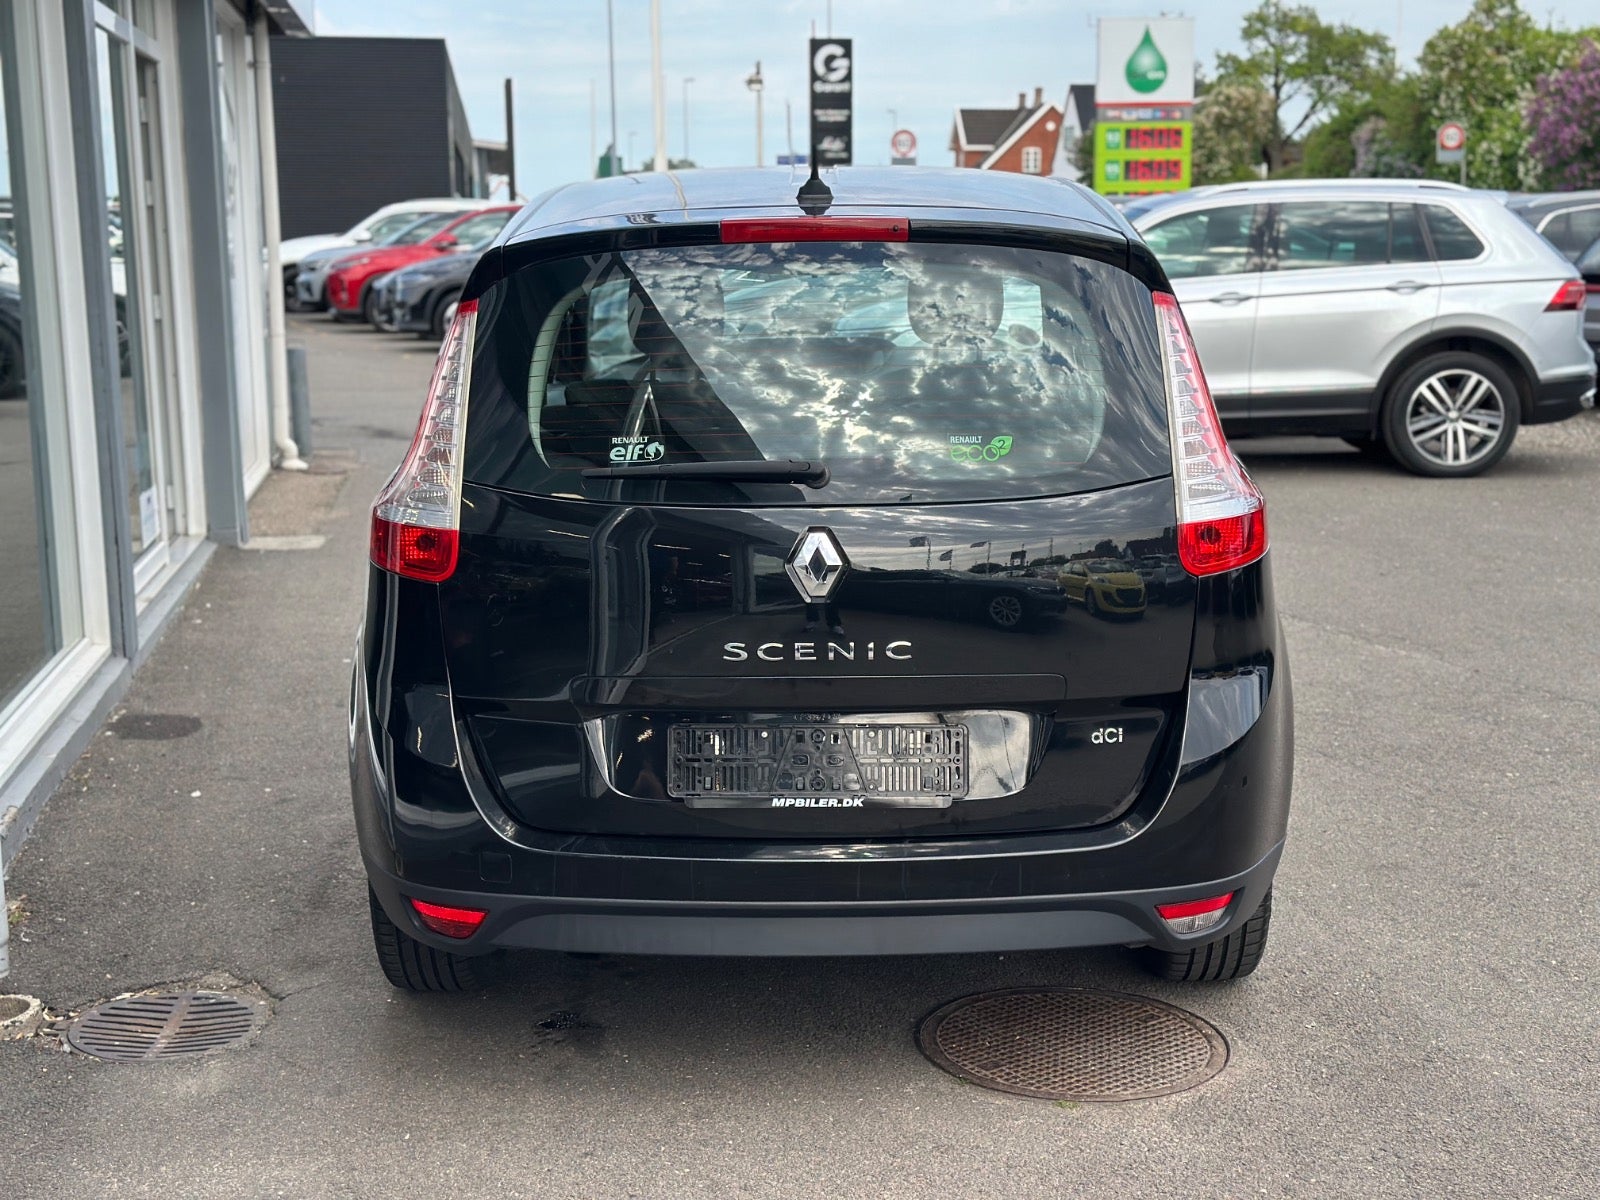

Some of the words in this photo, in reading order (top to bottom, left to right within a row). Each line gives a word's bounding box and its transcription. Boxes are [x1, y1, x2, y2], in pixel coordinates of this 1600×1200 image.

[611, 436, 649, 444] RENAULT
[950, 435, 982, 444] RENAULT
[609, 444, 645, 461] elf
[722, 641, 912, 661] SCENIC
[1091, 727, 1123, 744] dCi
[771, 798, 865, 808] MPBILER.DK
